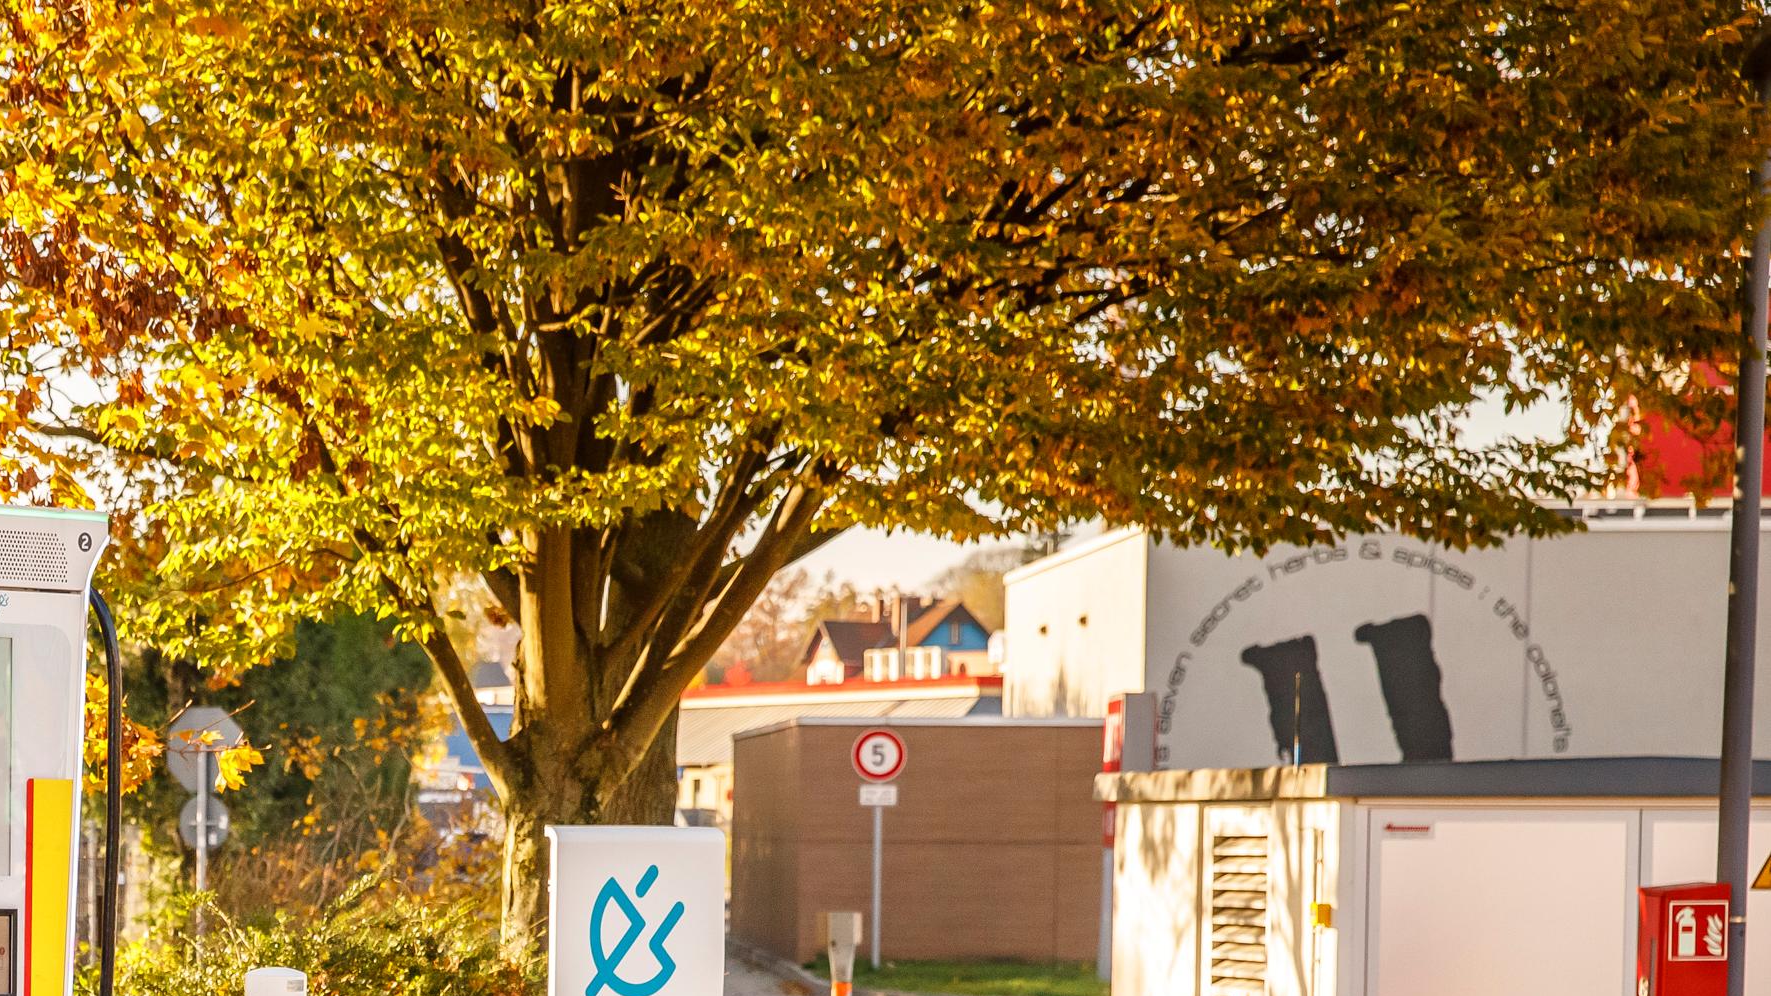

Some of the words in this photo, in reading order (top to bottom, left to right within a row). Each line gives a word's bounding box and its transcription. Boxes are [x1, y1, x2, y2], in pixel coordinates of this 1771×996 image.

[1156, 651, 1192, 735] eleven
[1190, 575, 1264, 647] secret
[1268, 546, 1349, 581] herbs
[1359, 540, 1382, 560] &
[1392, 547, 1475, 590] spices
[1492, 597, 1529, 640] the
[1527, 643, 1573, 752] colonel's
[871, 744, 885, 767] 5
